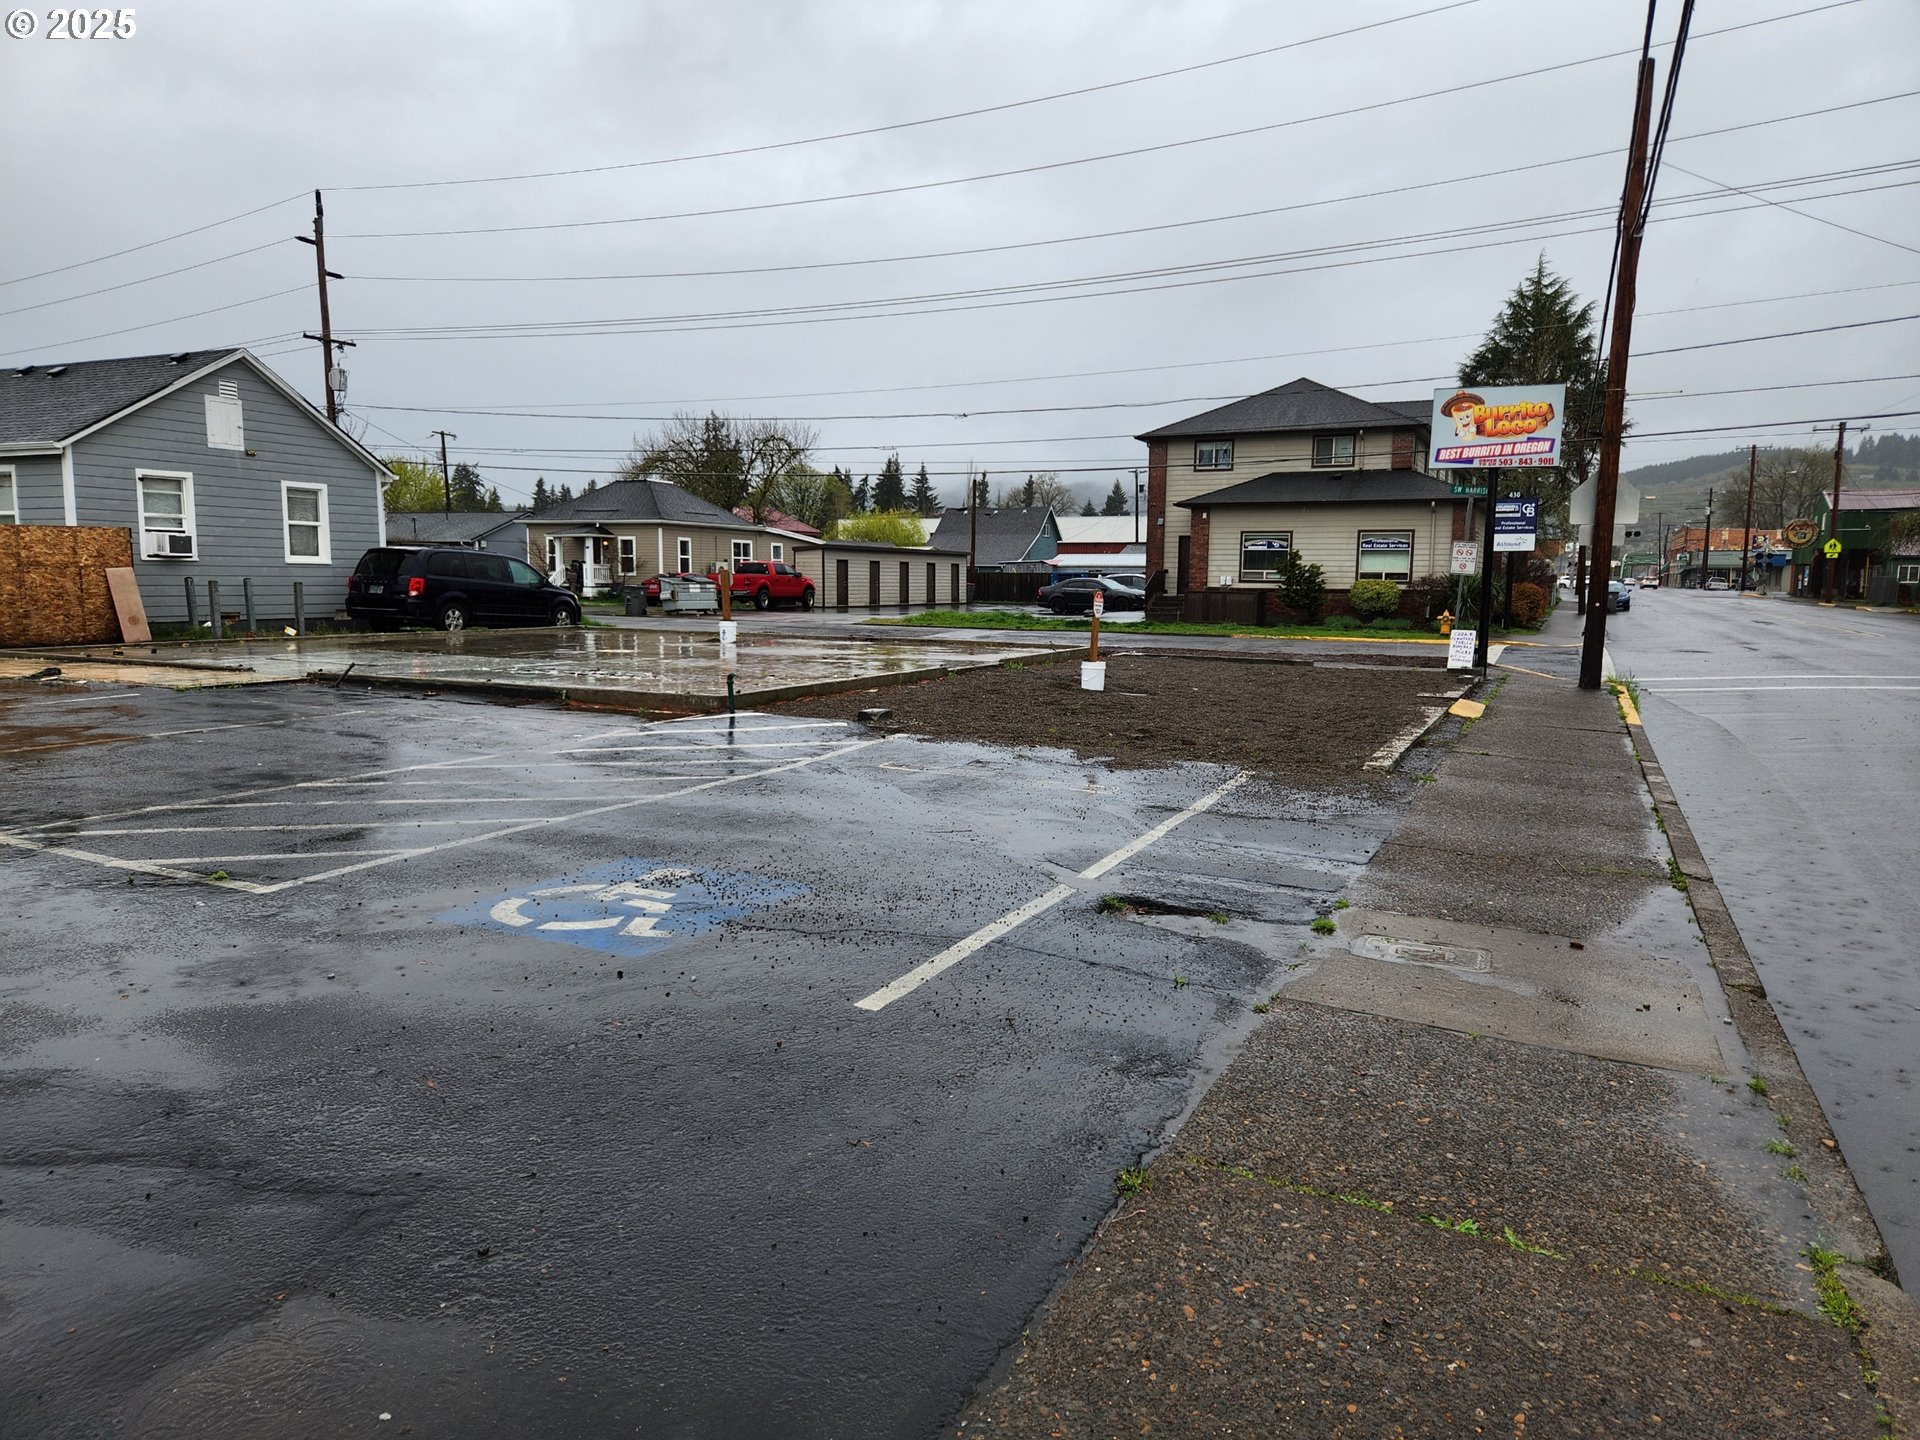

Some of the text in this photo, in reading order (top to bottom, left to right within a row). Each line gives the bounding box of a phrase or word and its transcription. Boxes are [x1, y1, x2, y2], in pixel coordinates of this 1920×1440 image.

[1473, 400, 1549, 424] Burrito
[1439, 441, 1551, 460] BEST BURRITO IN OREGON
